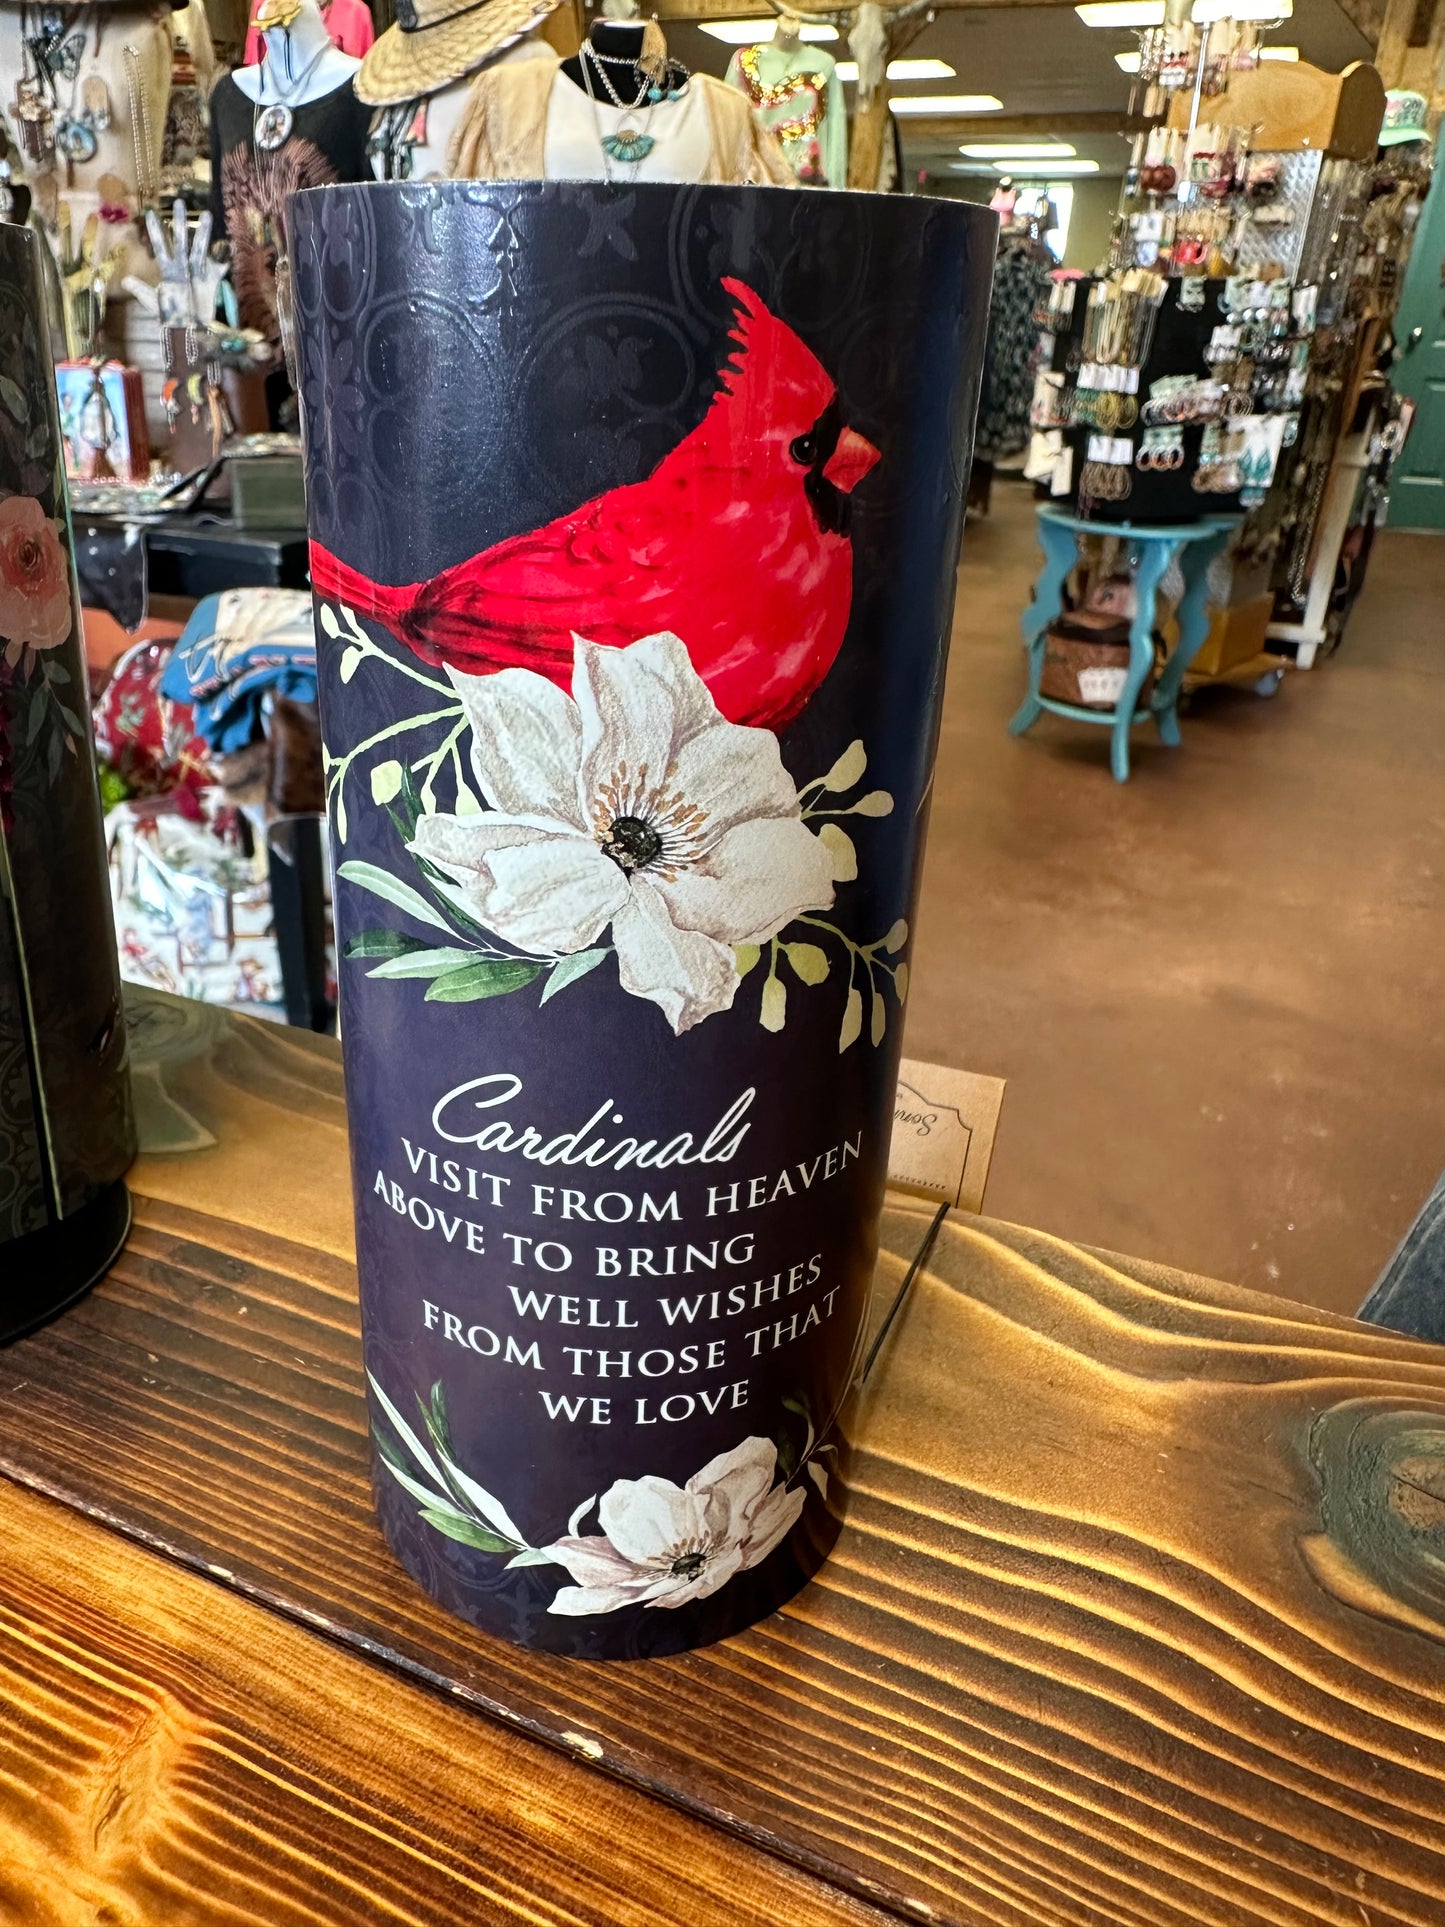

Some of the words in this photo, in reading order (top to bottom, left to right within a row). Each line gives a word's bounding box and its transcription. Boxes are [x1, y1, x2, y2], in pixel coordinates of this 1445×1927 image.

[431, 1073, 757, 1171] Cardinals
[373, 1169, 486, 1255] ABOVE
[502, 1232, 573, 1273] TO
[595, 1232, 756, 1277] BRING
[400, 1136, 511, 1208] VISIT
[530, 1183, 684, 1224] FROM
[704, 1129, 864, 1217] HEAVEN
[422, 1298, 546, 1371] FROM
[562, 1339, 726, 1378] THOSE
[744, 1284, 841, 1358] THAT
[506, 1284, 639, 1328] WELL
[655, 1253, 824, 1326] WISHES
[537, 1390, 612, 1425] WE
[634, 1378, 750, 1425] LOVE
